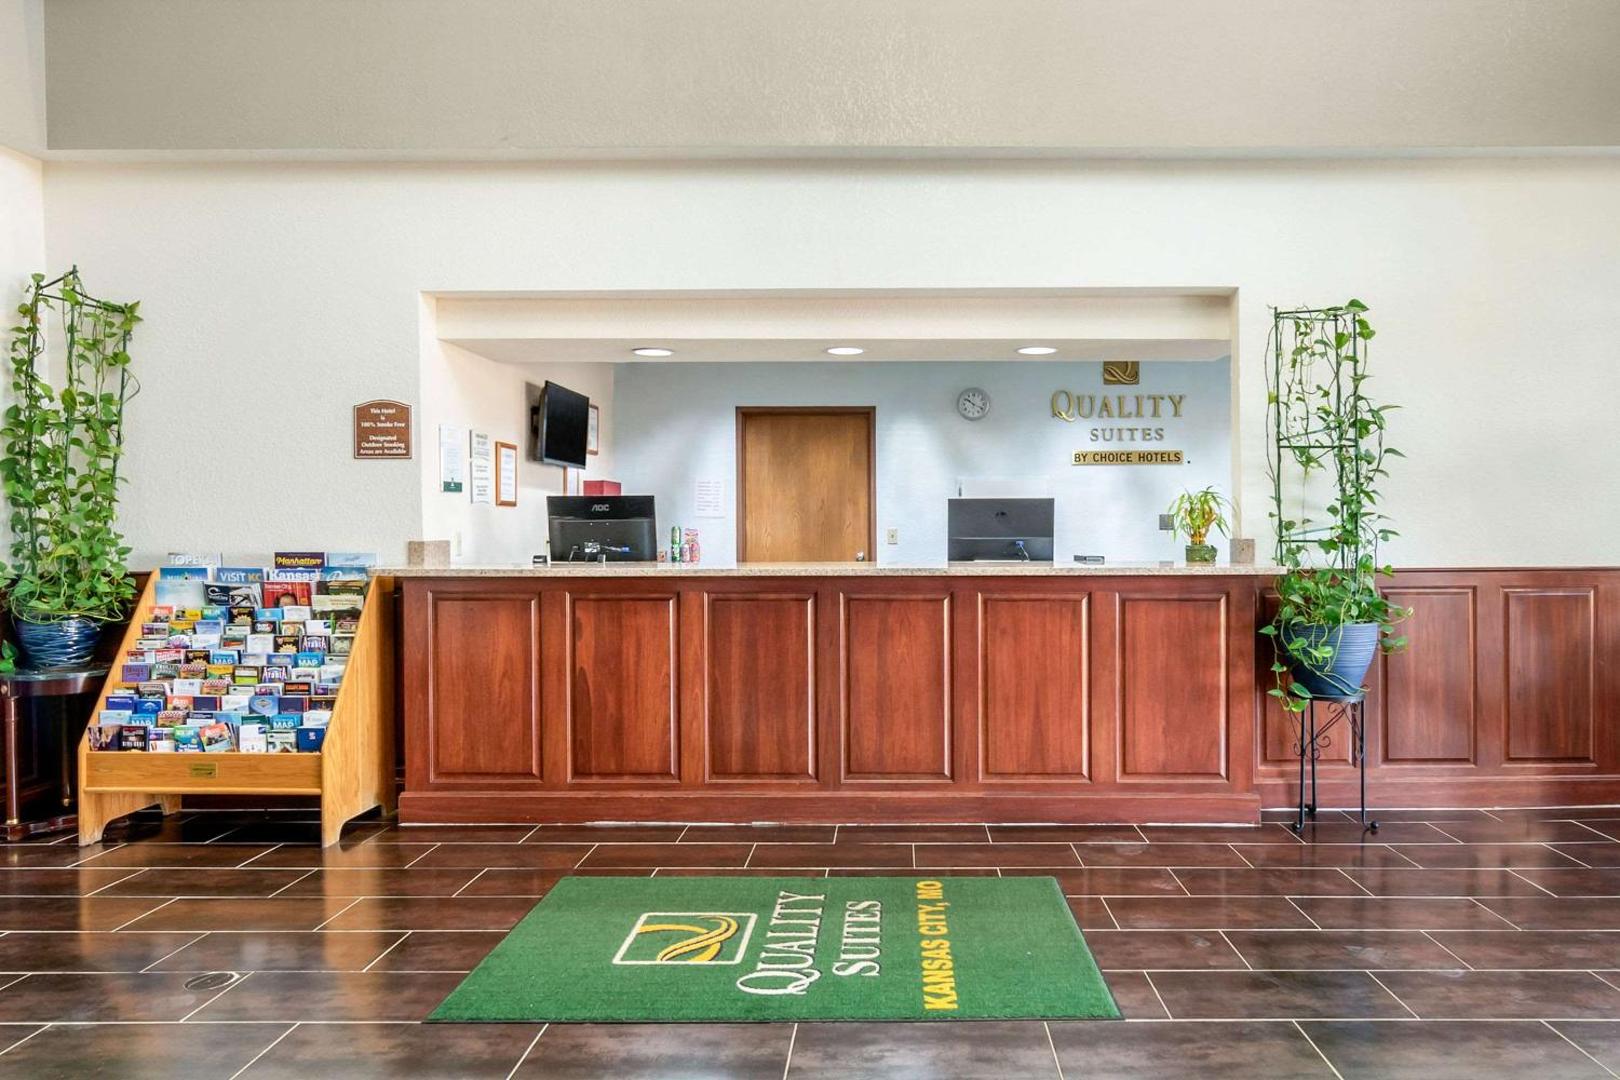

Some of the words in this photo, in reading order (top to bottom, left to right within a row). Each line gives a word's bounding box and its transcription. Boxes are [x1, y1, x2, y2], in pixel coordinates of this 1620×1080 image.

[1051, 390, 1185, 422] QUALITY
[1090, 428, 1164, 441] SUITES
[1074, 453, 1087, 462] BY
[1093, 453, 1132, 462] CHOICE
[1138, 453, 1181, 462] HOTELS
[276, 557, 321, 566] Manhattan
[220, 573, 246, 582] VISIT
[916, 880, 943, 900] MO
[916, 902, 951, 937] CITY,
[736, 891, 826, 996] QUALITY
[833, 900, 882, 977] SUITES
[918, 940, 959, 1011] KANSAS
